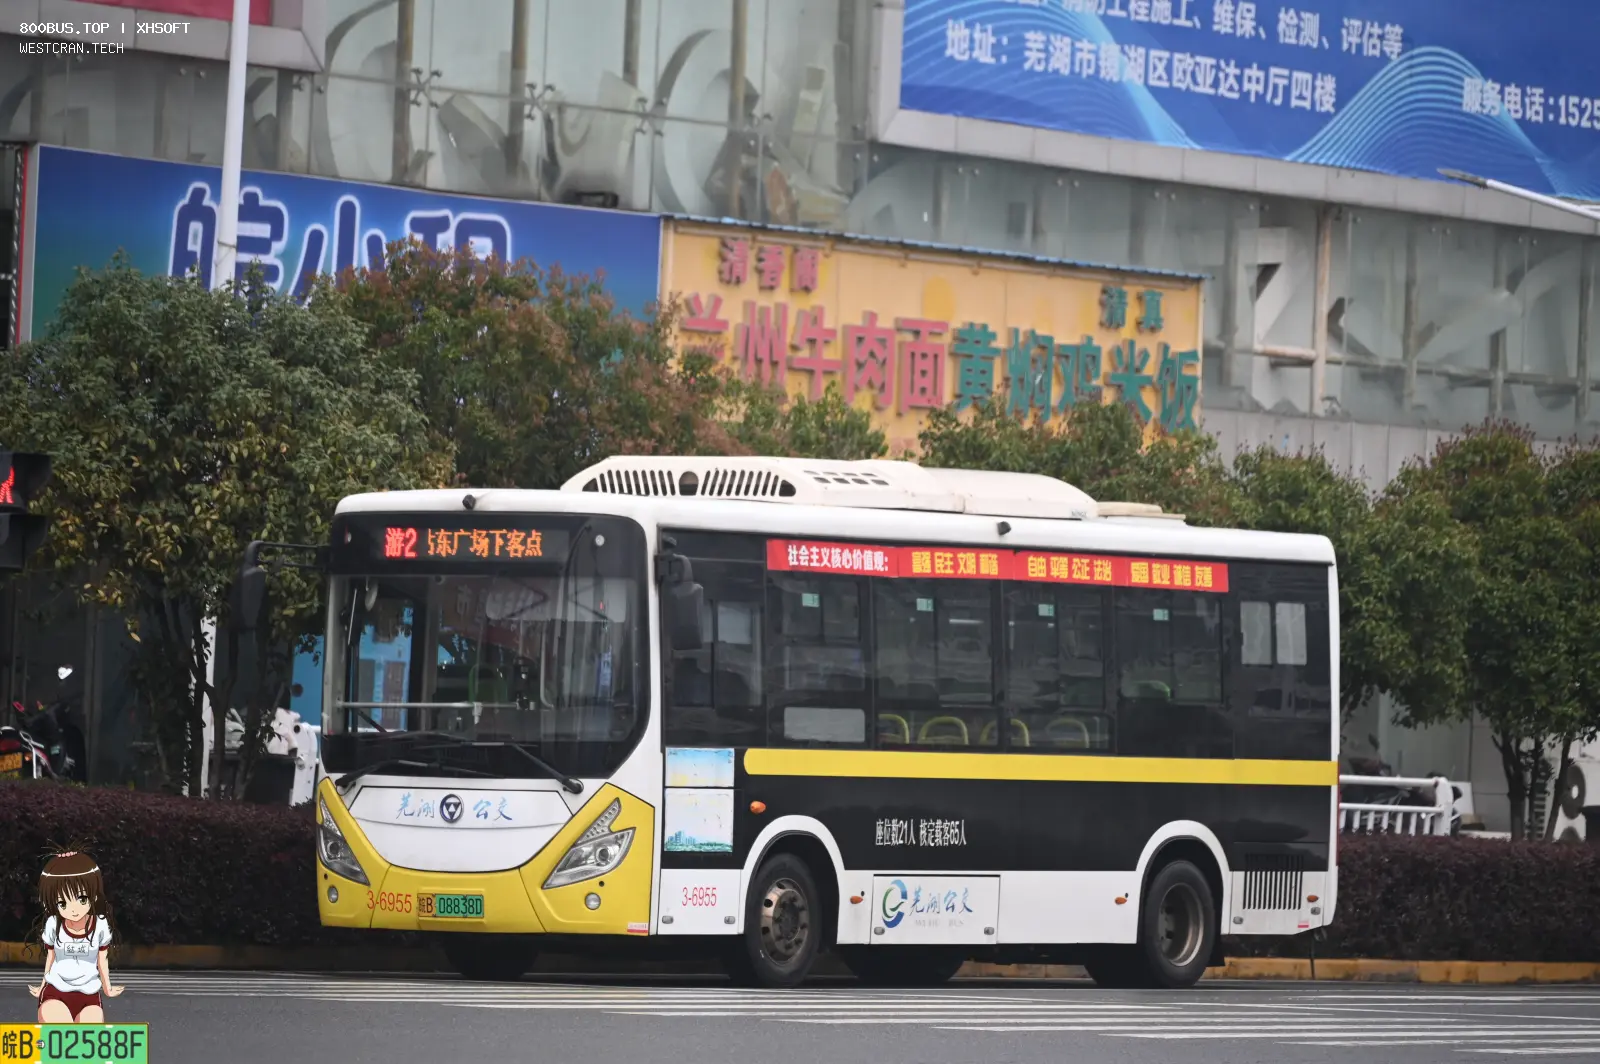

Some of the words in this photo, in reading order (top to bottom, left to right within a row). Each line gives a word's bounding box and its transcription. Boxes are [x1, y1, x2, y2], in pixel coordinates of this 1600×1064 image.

[1100, 285, 1164, 332] 清真
[385, 527, 418, 558] 游2
[875, 818, 916, 846] 座位数21人
[919, 818, 968, 847] 核定载客65人
[366, 890, 412, 914] 3-6955
[438, 896, 483, 915] 08838D
[681, 886, 718, 907] 3-6955
